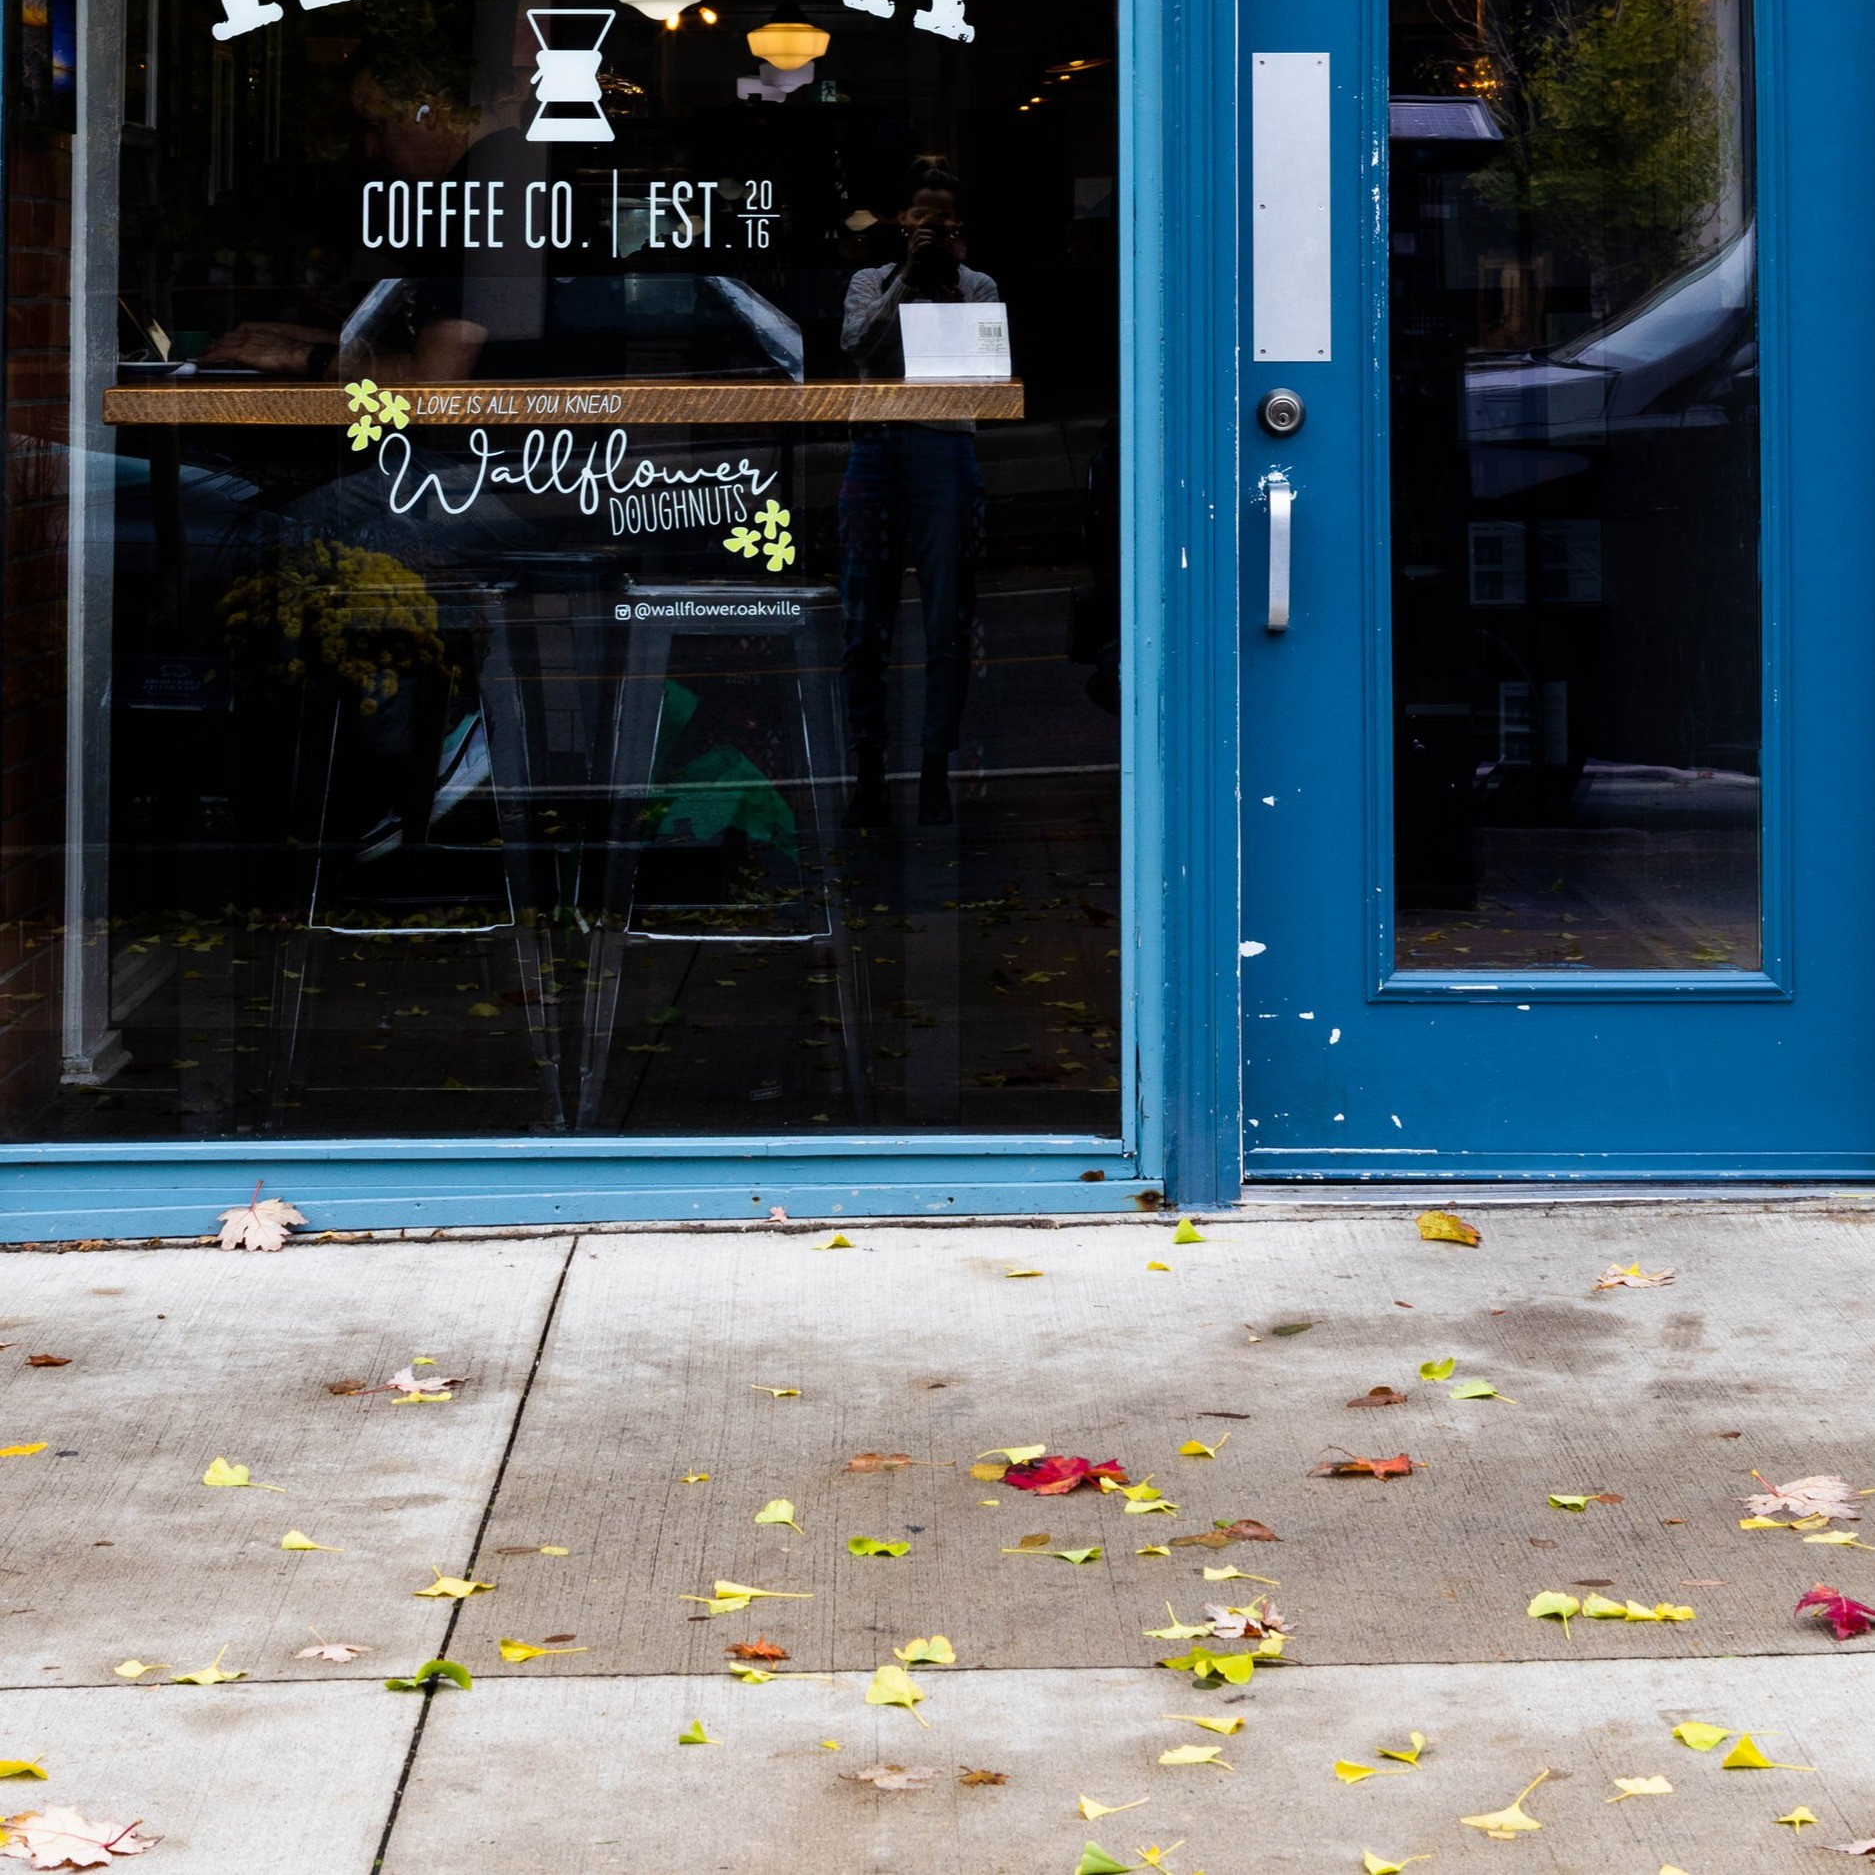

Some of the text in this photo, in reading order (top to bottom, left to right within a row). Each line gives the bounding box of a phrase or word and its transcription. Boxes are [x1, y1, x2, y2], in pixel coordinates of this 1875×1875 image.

[744, 179, 773, 211] 20
[361, 179, 733, 250] COFFEE CO. EST.
[744, 217, 770, 249] 16
[416, 394, 622, 415] LOVE IS ALL YOU KNEAD
[378, 427, 779, 515] Wallflower
[608, 483, 748, 536] DOUGHNUTS
[634, 600, 801, 620] @wallflower.oakville
